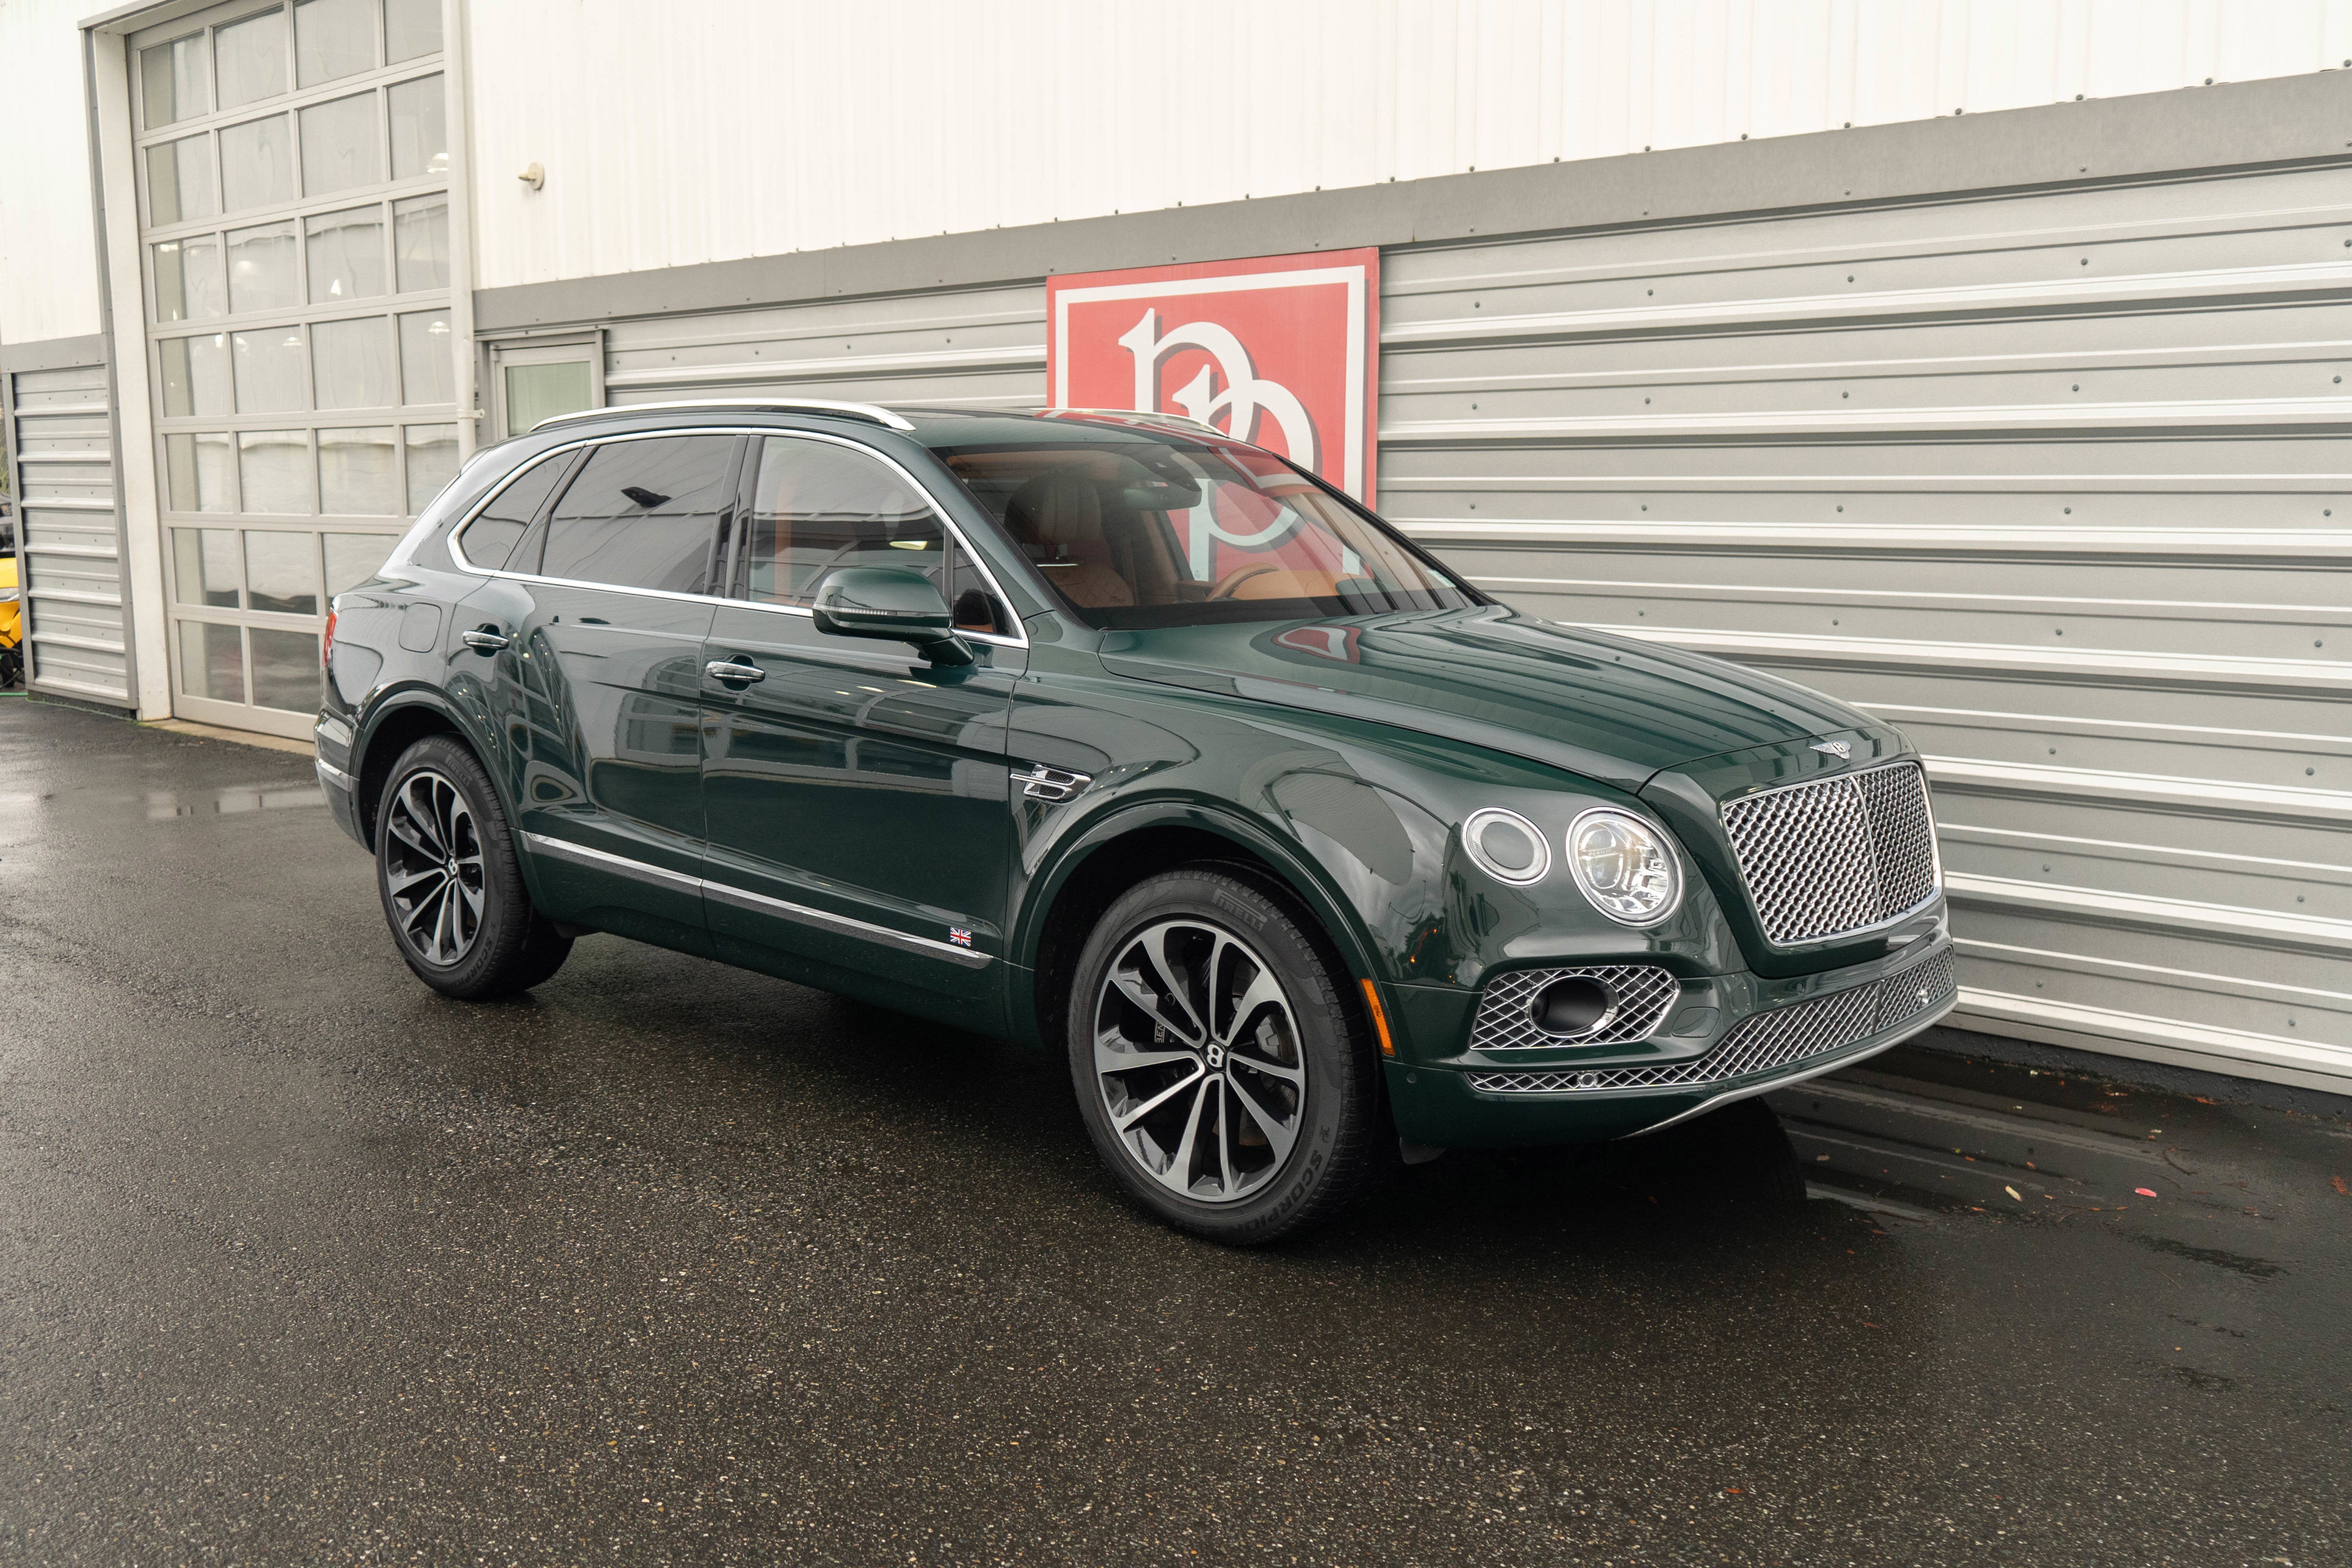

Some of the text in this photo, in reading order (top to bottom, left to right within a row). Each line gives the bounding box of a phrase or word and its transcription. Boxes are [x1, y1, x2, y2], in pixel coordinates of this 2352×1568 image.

[445, 754, 472, 786] PIRELLI
[1211, 888, 1268, 932] PIRELLI
[1207, 1044, 1225, 1067] B
[1228, 1149, 1323, 1234] SCORPION
